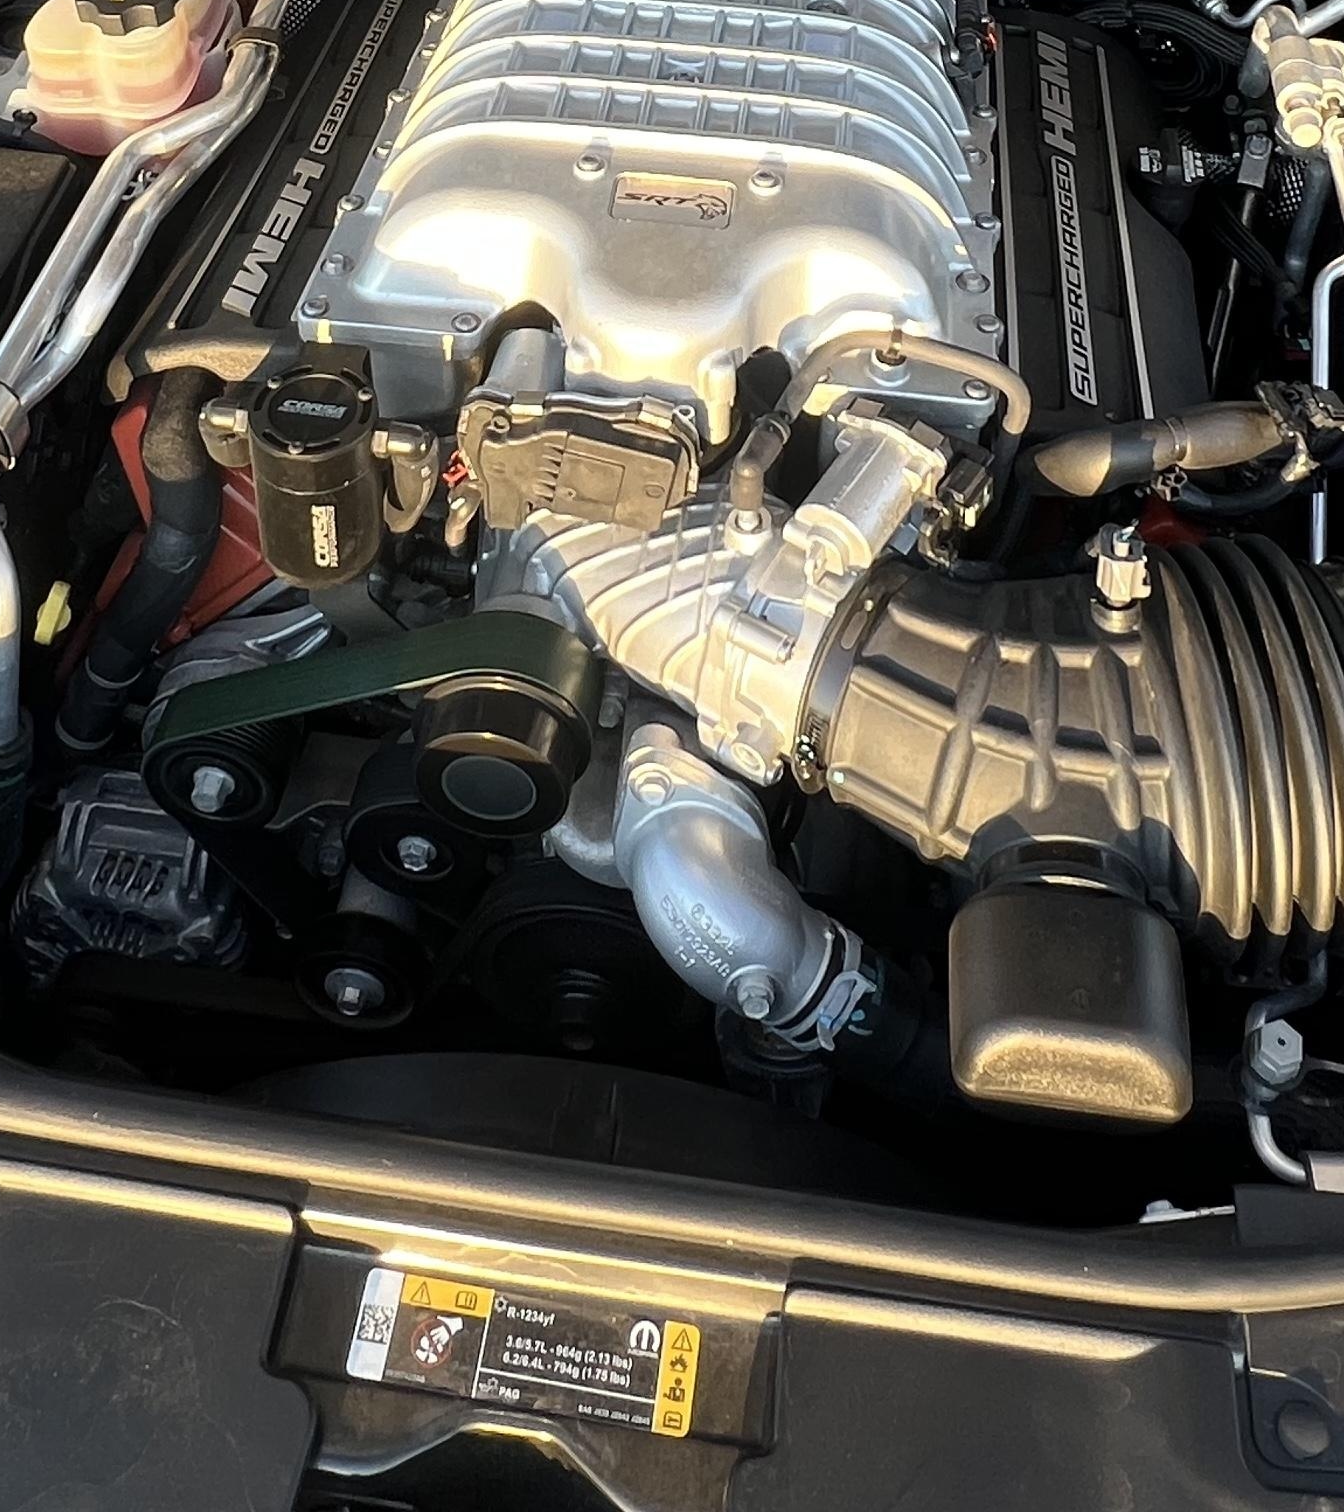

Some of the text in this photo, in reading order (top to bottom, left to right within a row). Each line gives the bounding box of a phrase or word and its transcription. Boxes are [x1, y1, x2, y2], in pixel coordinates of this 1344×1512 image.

[222, 157, 325, 317] HEMI
[617, 193, 697, 206] SRT
[1036, 31, 1097, 405] SUPERCHARGED HEMI
[506, 1306, 556, 1327] R-1234yf
